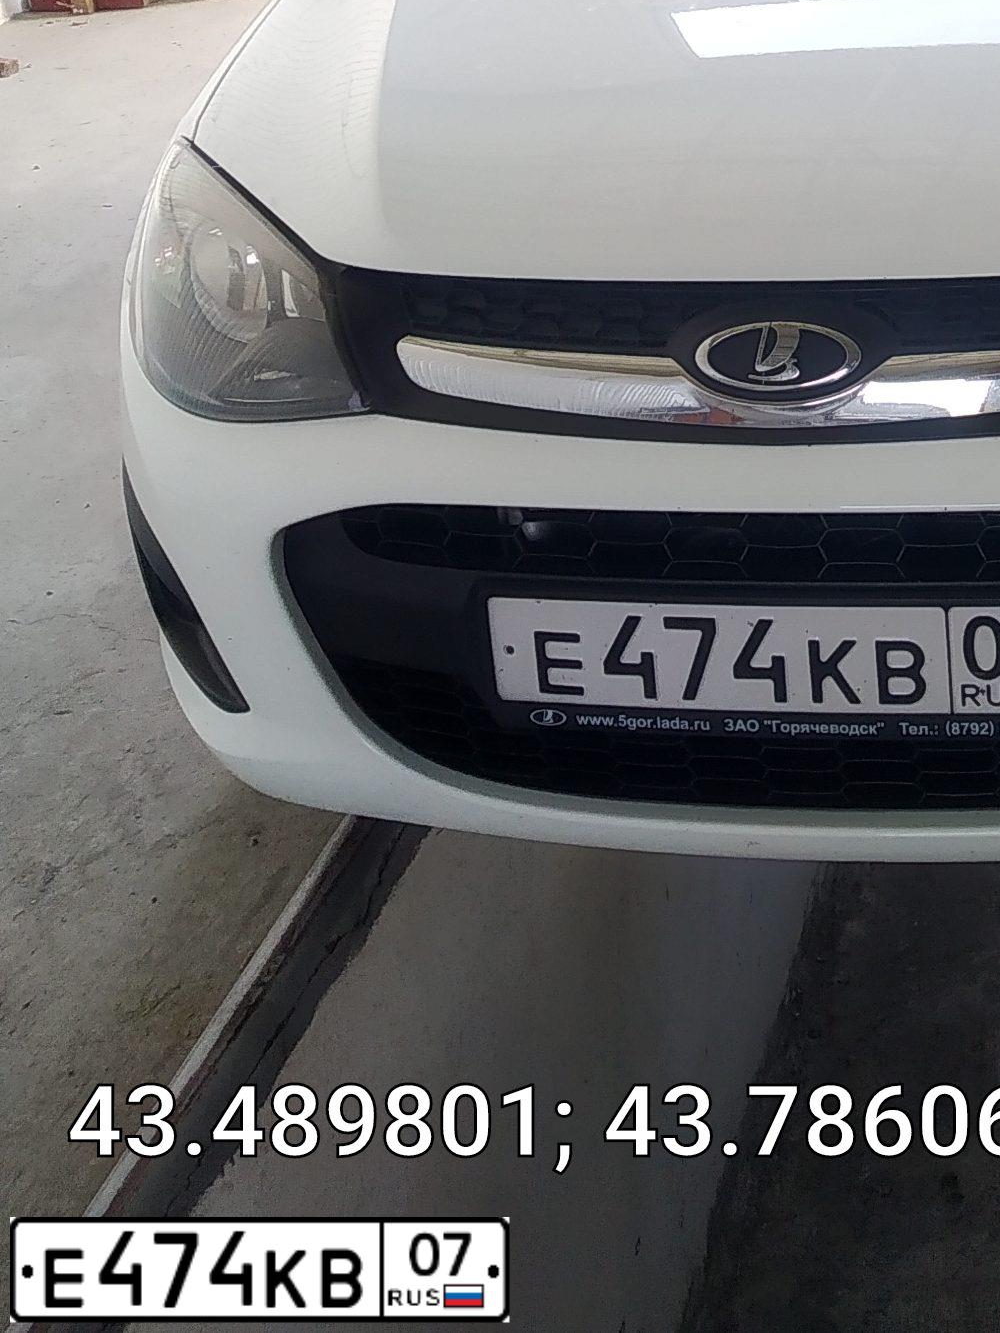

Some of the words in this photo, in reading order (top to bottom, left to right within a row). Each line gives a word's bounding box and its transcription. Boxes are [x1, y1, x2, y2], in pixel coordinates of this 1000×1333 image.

[576, 713, 711, 732] www.5gor.lada.ru
[723, 718, 760, 733] ЗАО
[763, 719, 885, 738] "Горячеводск"
[899, 722, 939, 736] Тел.:
[945, 721, 994, 737] (8792)
